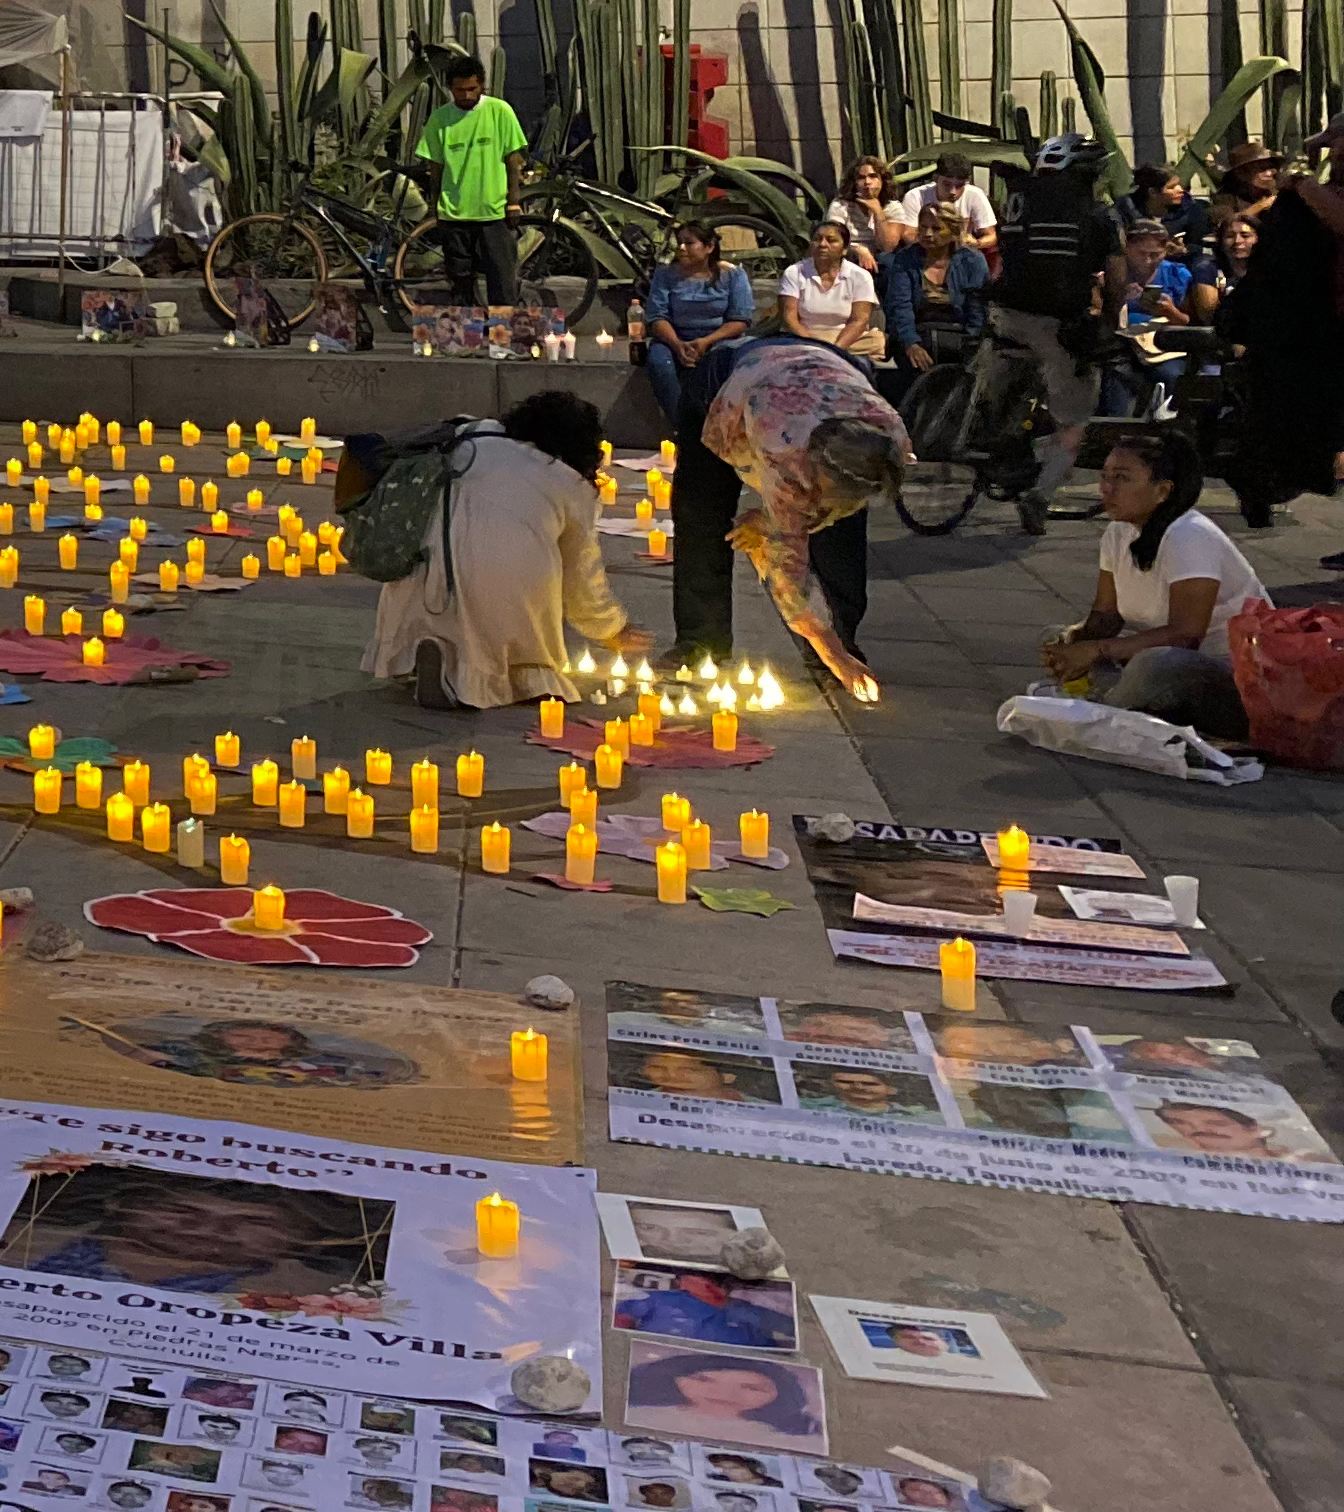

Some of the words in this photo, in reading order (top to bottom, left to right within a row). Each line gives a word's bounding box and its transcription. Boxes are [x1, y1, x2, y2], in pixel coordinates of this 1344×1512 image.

[97, 1122, 206, 1144] sigo
[222, 1135, 488, 1180] buscando
[12, 1313, 79, 1329] 2009
[86, 1324, 118, 1335] en
[128, 1328, 228, 1352] Piedras
[116, 1293, 352, 1342] Oropeza
[364, 1329, 504, 1360] Villa
[154, 1324, 178, 1334] el
[186, 1327, 215, 1338] 21
[226, 1334, 261, 1347] de
[270, 1341, 357, 1361] marzo
[366, 1355, 401, 1367] de
